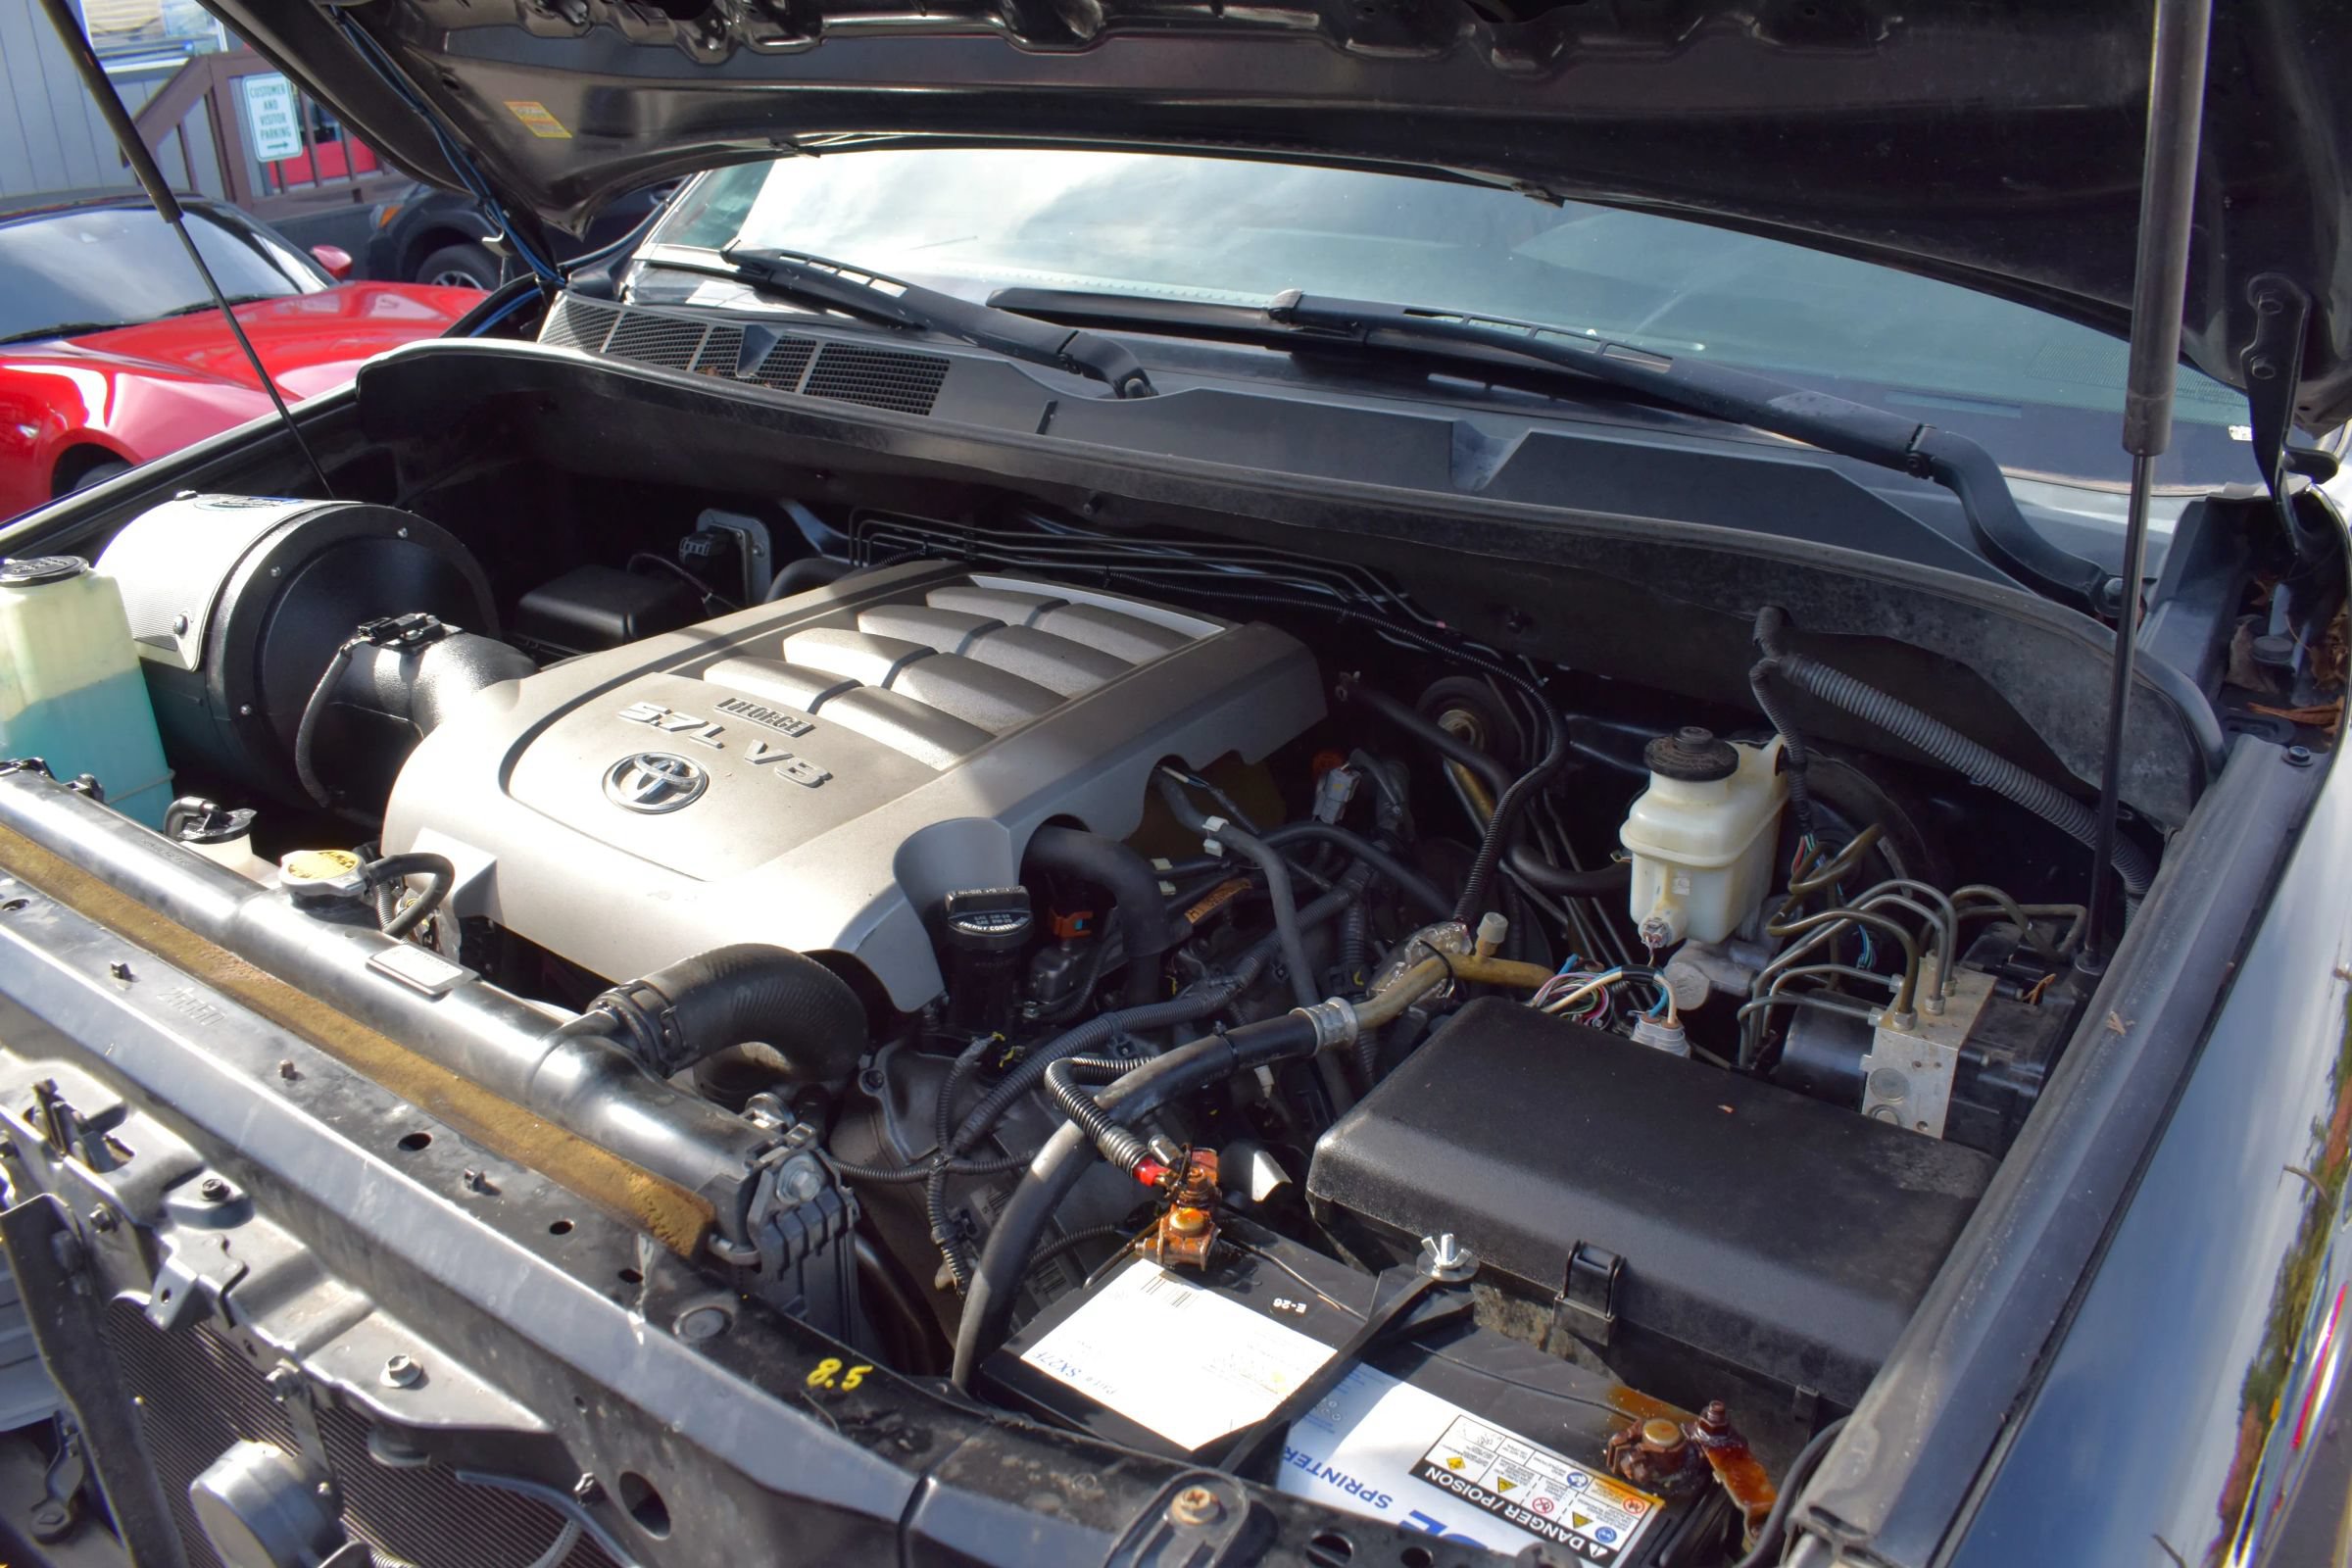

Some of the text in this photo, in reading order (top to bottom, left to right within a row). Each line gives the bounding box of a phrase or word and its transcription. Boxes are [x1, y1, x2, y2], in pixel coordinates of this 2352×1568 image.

[250, 84, 285, 97] CUSTOMER
[264, 100, 278, 109] AND
[260, 114, 286, 125] VISITOR
[260, 127, 291, 140] PARKING
[617, 701, 833, 788] 5.7L V8
[958, 921, 988, 932] ENERGY
[1283, 1446, 1394, 1509] SPRINTER
[1503, 1501, 1588, 1551] DANGER
